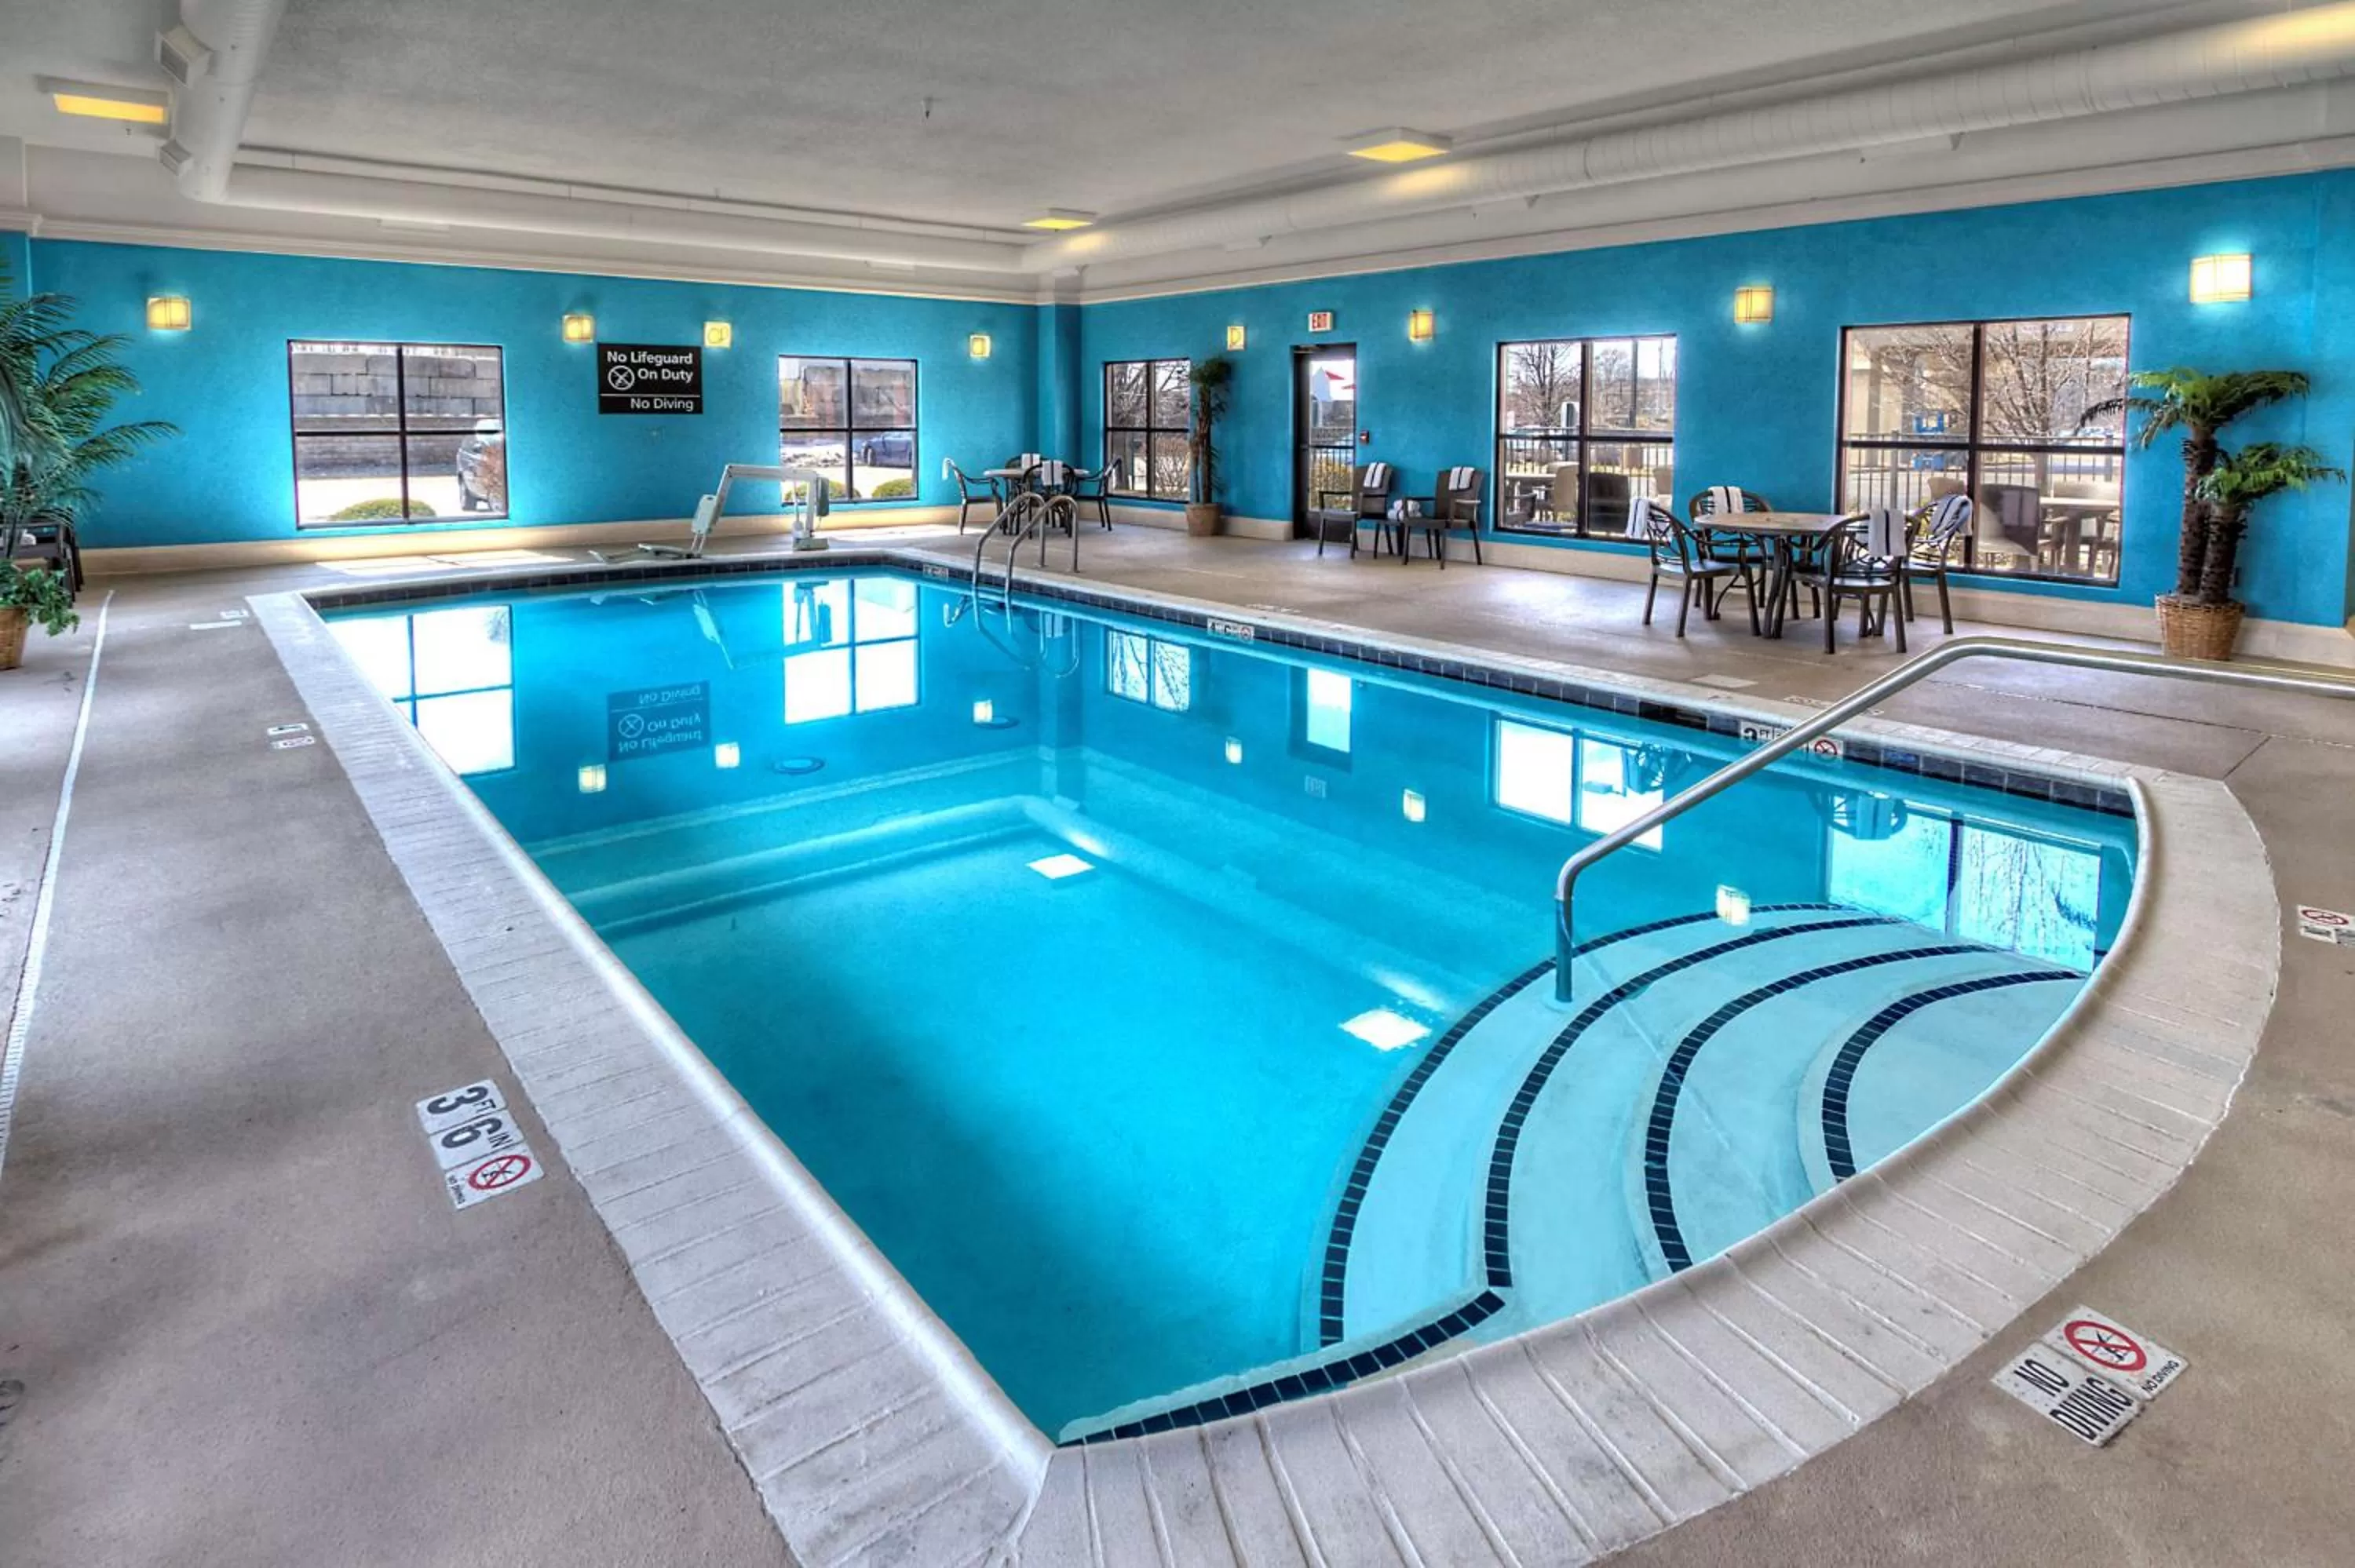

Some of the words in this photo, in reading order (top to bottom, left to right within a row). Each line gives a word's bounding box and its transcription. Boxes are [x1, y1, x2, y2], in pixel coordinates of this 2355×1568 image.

[607, 351, 627, 363] No
[630, 351, 693, 366] Lifeguard
[637, 368, 658, 380] On
[661, 368, 693, 384] Duty
[630, 398, 650, 409] No
[653, 398, 694, 412] Diving
[427, 1085, 488, 1114] 3
[474, 1099, 496, 1114] FT
[441, 1118, 502, 1149] 6
[487, 1132, 513, 1148] IN
[2014, 1358, 2070, 1397] NO
[2141, 1379, 2157, 1393] NO
[2154, 1360, 2180, 1383] DIVING
[2049, 1376, 2134, 1441] DIVING
